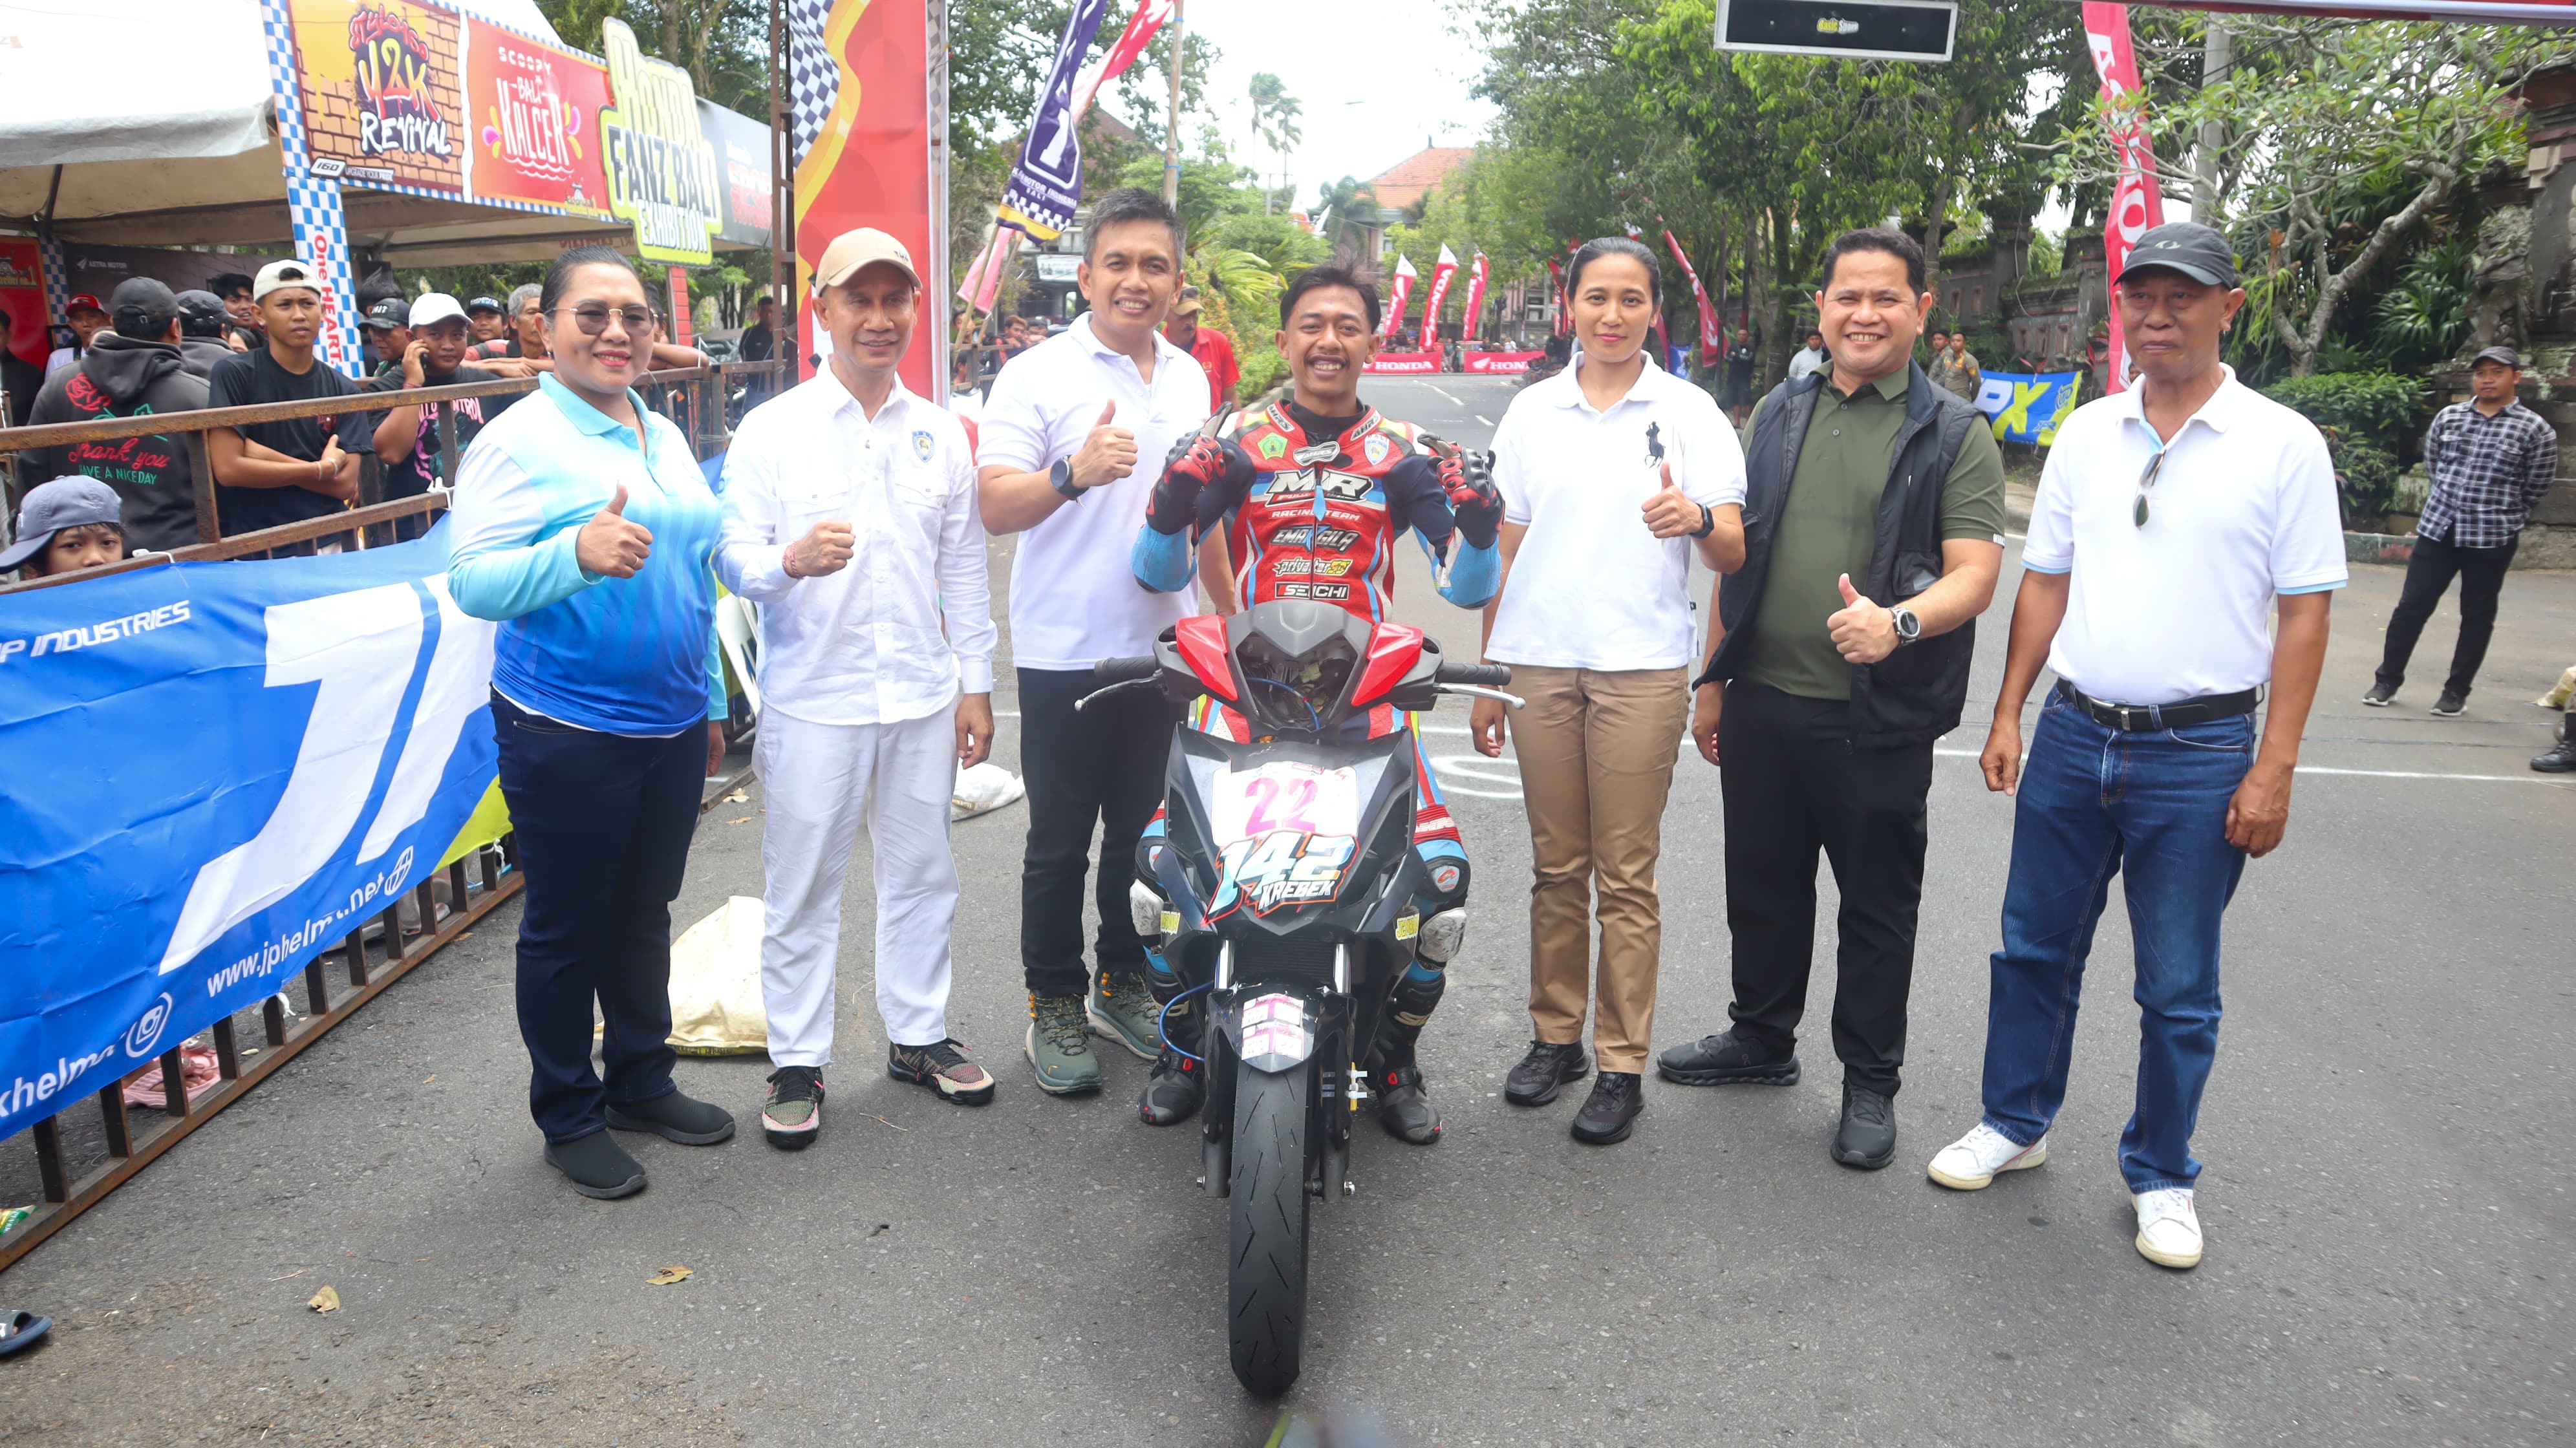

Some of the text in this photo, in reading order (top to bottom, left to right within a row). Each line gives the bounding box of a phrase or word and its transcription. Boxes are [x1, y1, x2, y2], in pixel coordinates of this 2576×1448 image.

[358, 37, 441, 122] Y2K
[499, 47, 551, 74] SCOOPY
[611, 35, 703, 145] HONDA
[360, 111, 451, 153] REVIVAL
[497, 78, 569, 165] KALCER
[317, 162, 339, 171] 160
[606, 124, 671, 205] FANZ
[671, 142, 718, 218] BALI
[638, 199, 709, 253] EXHIBITION
[314, 235, 342, 365] One HEART.
[1375, 361, 1433, 370] HONDA
[1490, 361, 1529, 370] HON
[105, 465, 113, 478] A
[132, 451, 171, 470] you
[1326, 509, 1360, 520] TEAM
[0, 599, 191, 663] P INDUSTRIES
[1245, 777, 1318, 836] 22
[1258, 880, 1335, 911] KREBEK
